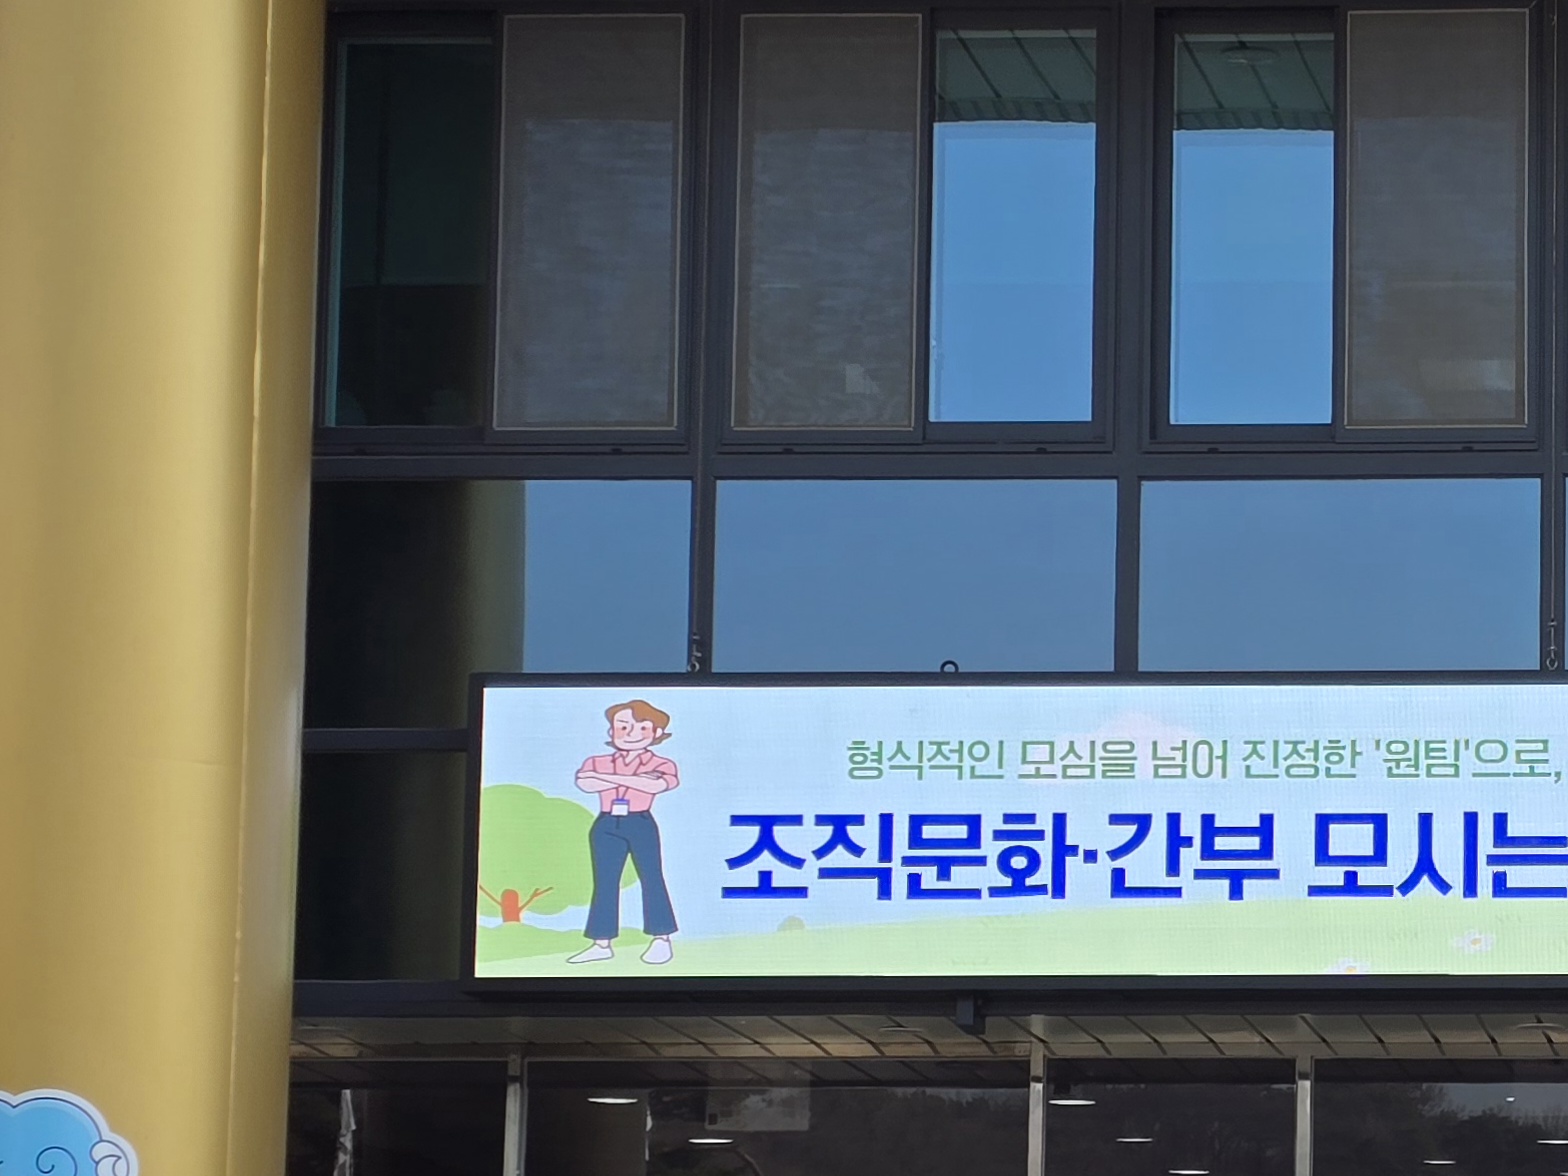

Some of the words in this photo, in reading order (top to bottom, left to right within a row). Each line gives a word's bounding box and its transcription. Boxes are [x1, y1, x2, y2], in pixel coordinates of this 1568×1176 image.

[847, 740, 1005, 780] 형식적인
[1018, 740, 1137, 780] 모심을
[1151, 739, 1228, 779] 넘어
[1242, 739, 1363, 779] 진정한
[1374, 738, 1562, 784] '원팀'으로,
